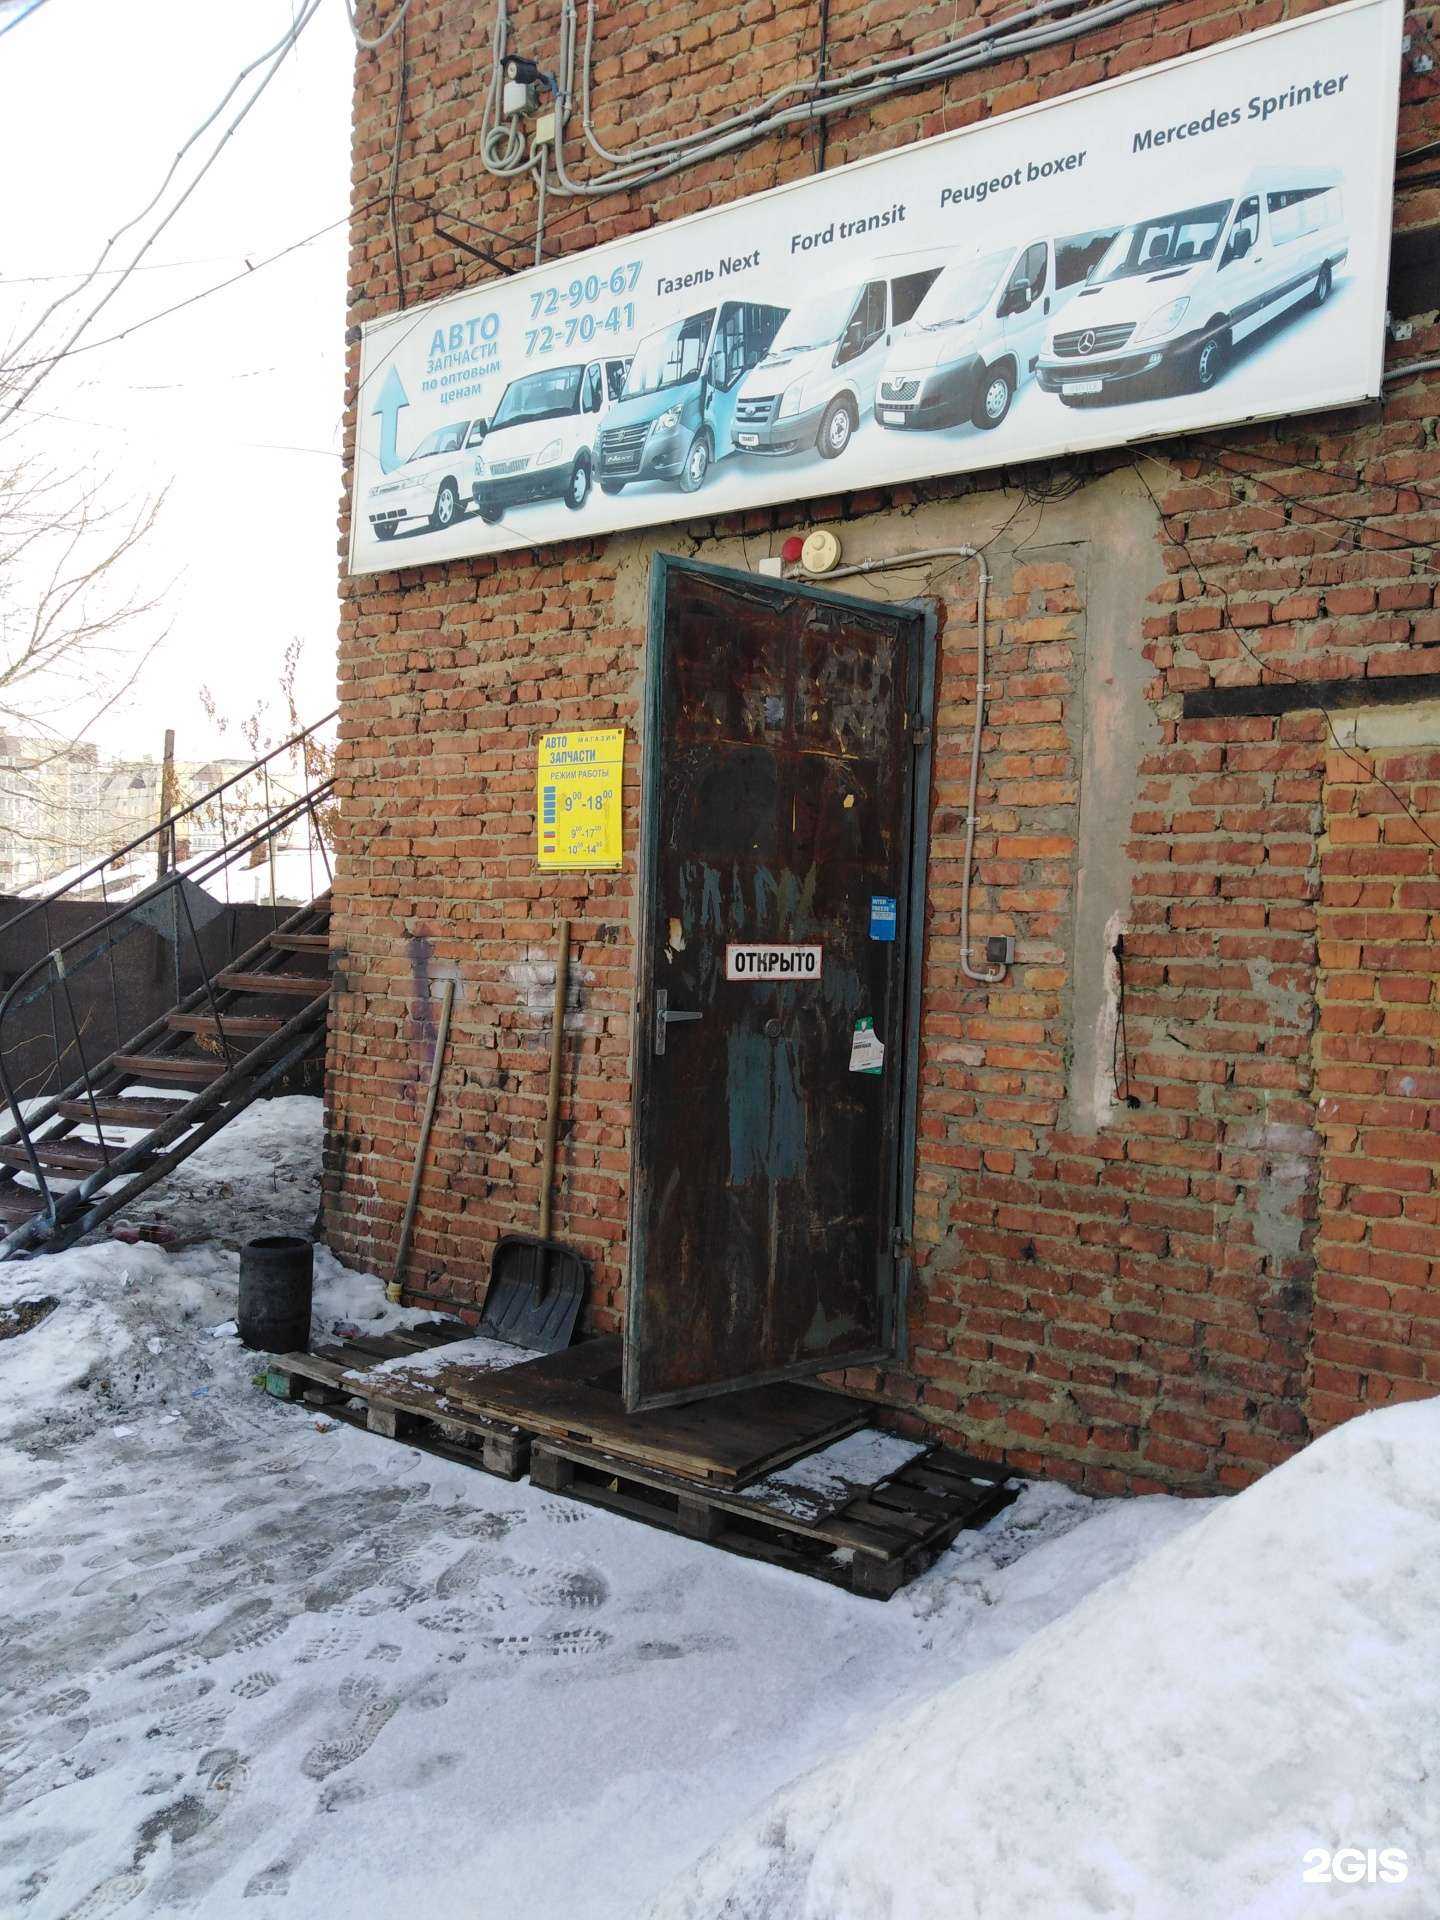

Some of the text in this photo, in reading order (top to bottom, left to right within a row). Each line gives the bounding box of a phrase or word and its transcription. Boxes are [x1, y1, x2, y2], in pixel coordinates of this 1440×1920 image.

[1132, 73, 1349, 153] Mercedes Sprinter
[940, 150, 1087, 208] Peugeot boxer
[791, 203, 906, 254] Ford transit
[529, 260, 643, 320] 72-90-67
[657, 250, 761, 296] Газель Next
[429, 312, 499, 357] АВТО
[525, 302, 636, 358] 72-70-41
[422, 360, 501, 391] по оптовым
[427, 342, 497, 374] ЗАПЧАСТИ
[440, 383, 481, 404] ценам
[545, 736, 567, 749] АВТО
[550, 749, 596, 764] ЗАПЧАСТИ
[550, 769, 609, 780] РЕЖИМ РАБОТЫ
[735, 953, 815, 972] ОТКРЫТО
